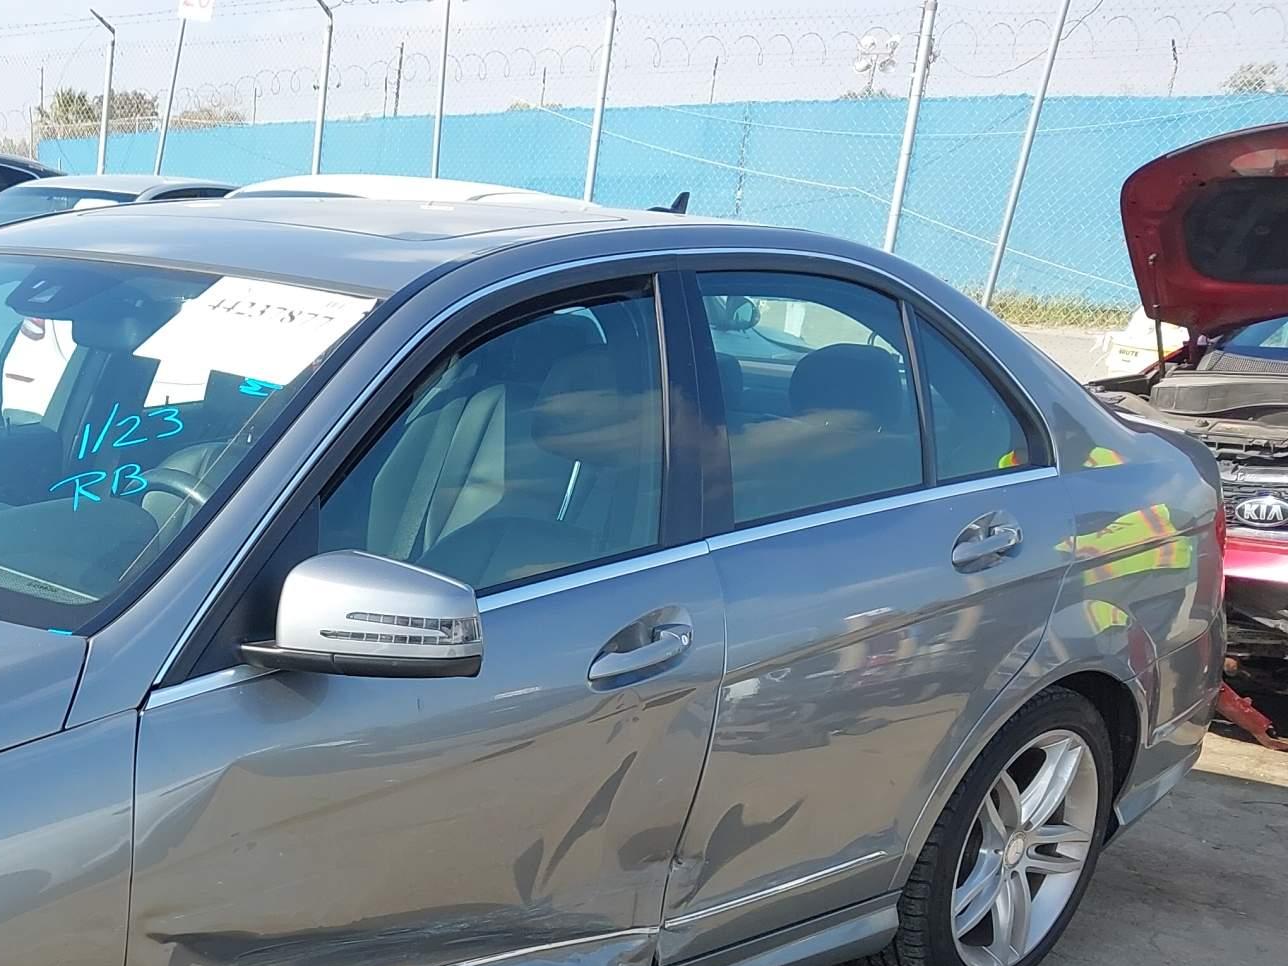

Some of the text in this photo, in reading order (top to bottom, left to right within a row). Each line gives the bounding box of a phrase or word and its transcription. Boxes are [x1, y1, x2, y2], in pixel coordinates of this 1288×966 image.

[78, 402, 183, 459] 1/23
[49, 463, 148, 512] RB
[1243, 503, 1284, 521] KIA
